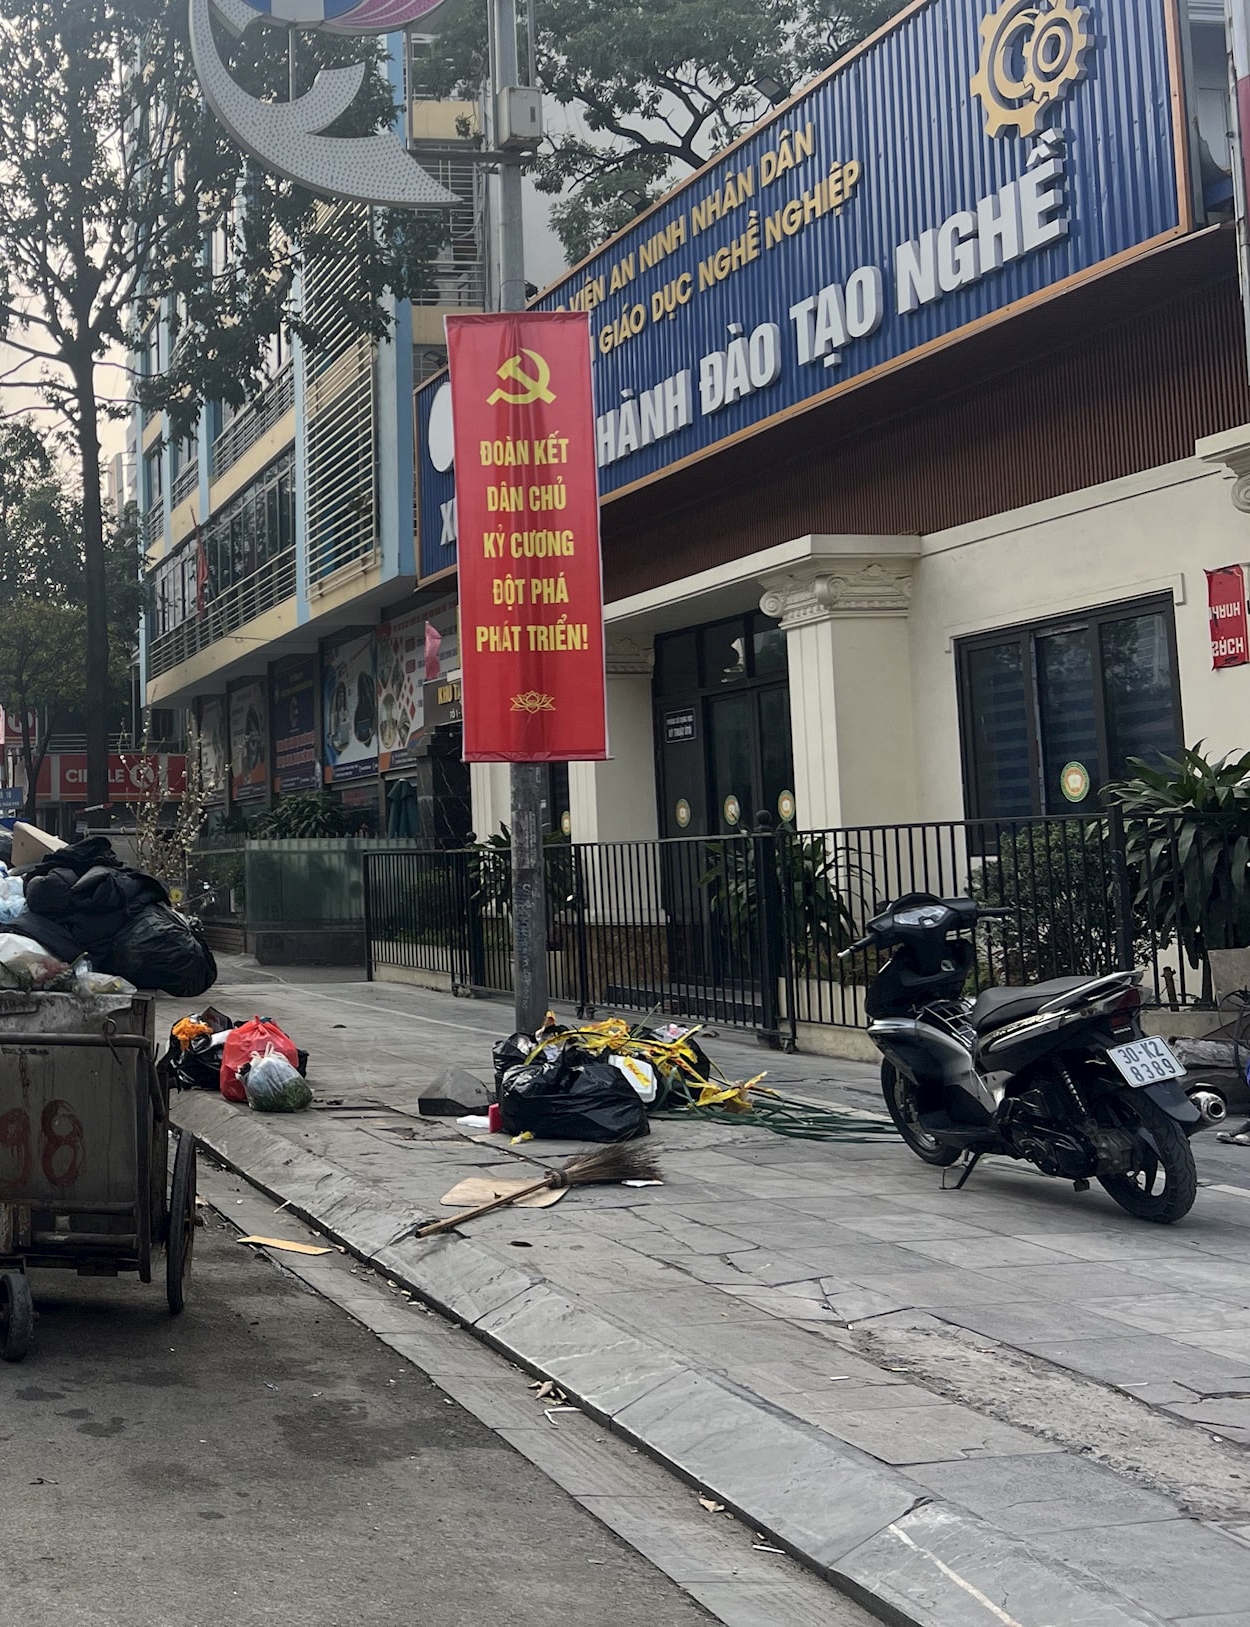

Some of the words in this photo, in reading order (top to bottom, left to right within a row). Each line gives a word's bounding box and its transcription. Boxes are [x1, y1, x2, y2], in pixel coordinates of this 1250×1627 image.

[609, 253, 635, 295] AN
[639, 215, 686, 273] NINH
[691, 165, 754, 236] NHÂN
[761, 122, 815, 187] DÂN
[599, 302, 647, 354] GIÁO
[652, 272, 693, 323] DỤC
[698, 210, 761, 292] NGHỀ
[765, 159, 862, 250] NGHIỆP
[699, 322, 782, 416] ĐÀO
[789, 265, 883, 369] TẠO
[895, 127, 1069, 316] NGHỀ
[480, 436, 529, 466] ĐOÀN
[534, 431, 569, 465] KẾT
[487, 481, 524, 512] DÂN
[529, 476, 566, 511] CHỦ
[483, 524, 506, 558] KỶ
[510, 529, 574, 558] CƯƠNG
[493, 574, 525, 610] ĐỘT
[531, 572, 569, 604] PHÁ
[476, 620, 522, 652] PHÁT
[526, 614, 589, 651] TRIỂN!
[65, 768, 124, 783] CILE
[1118, 1041, 1164, 1064] 30-K2
[1130, 1058, 1175, 1083] 8389
